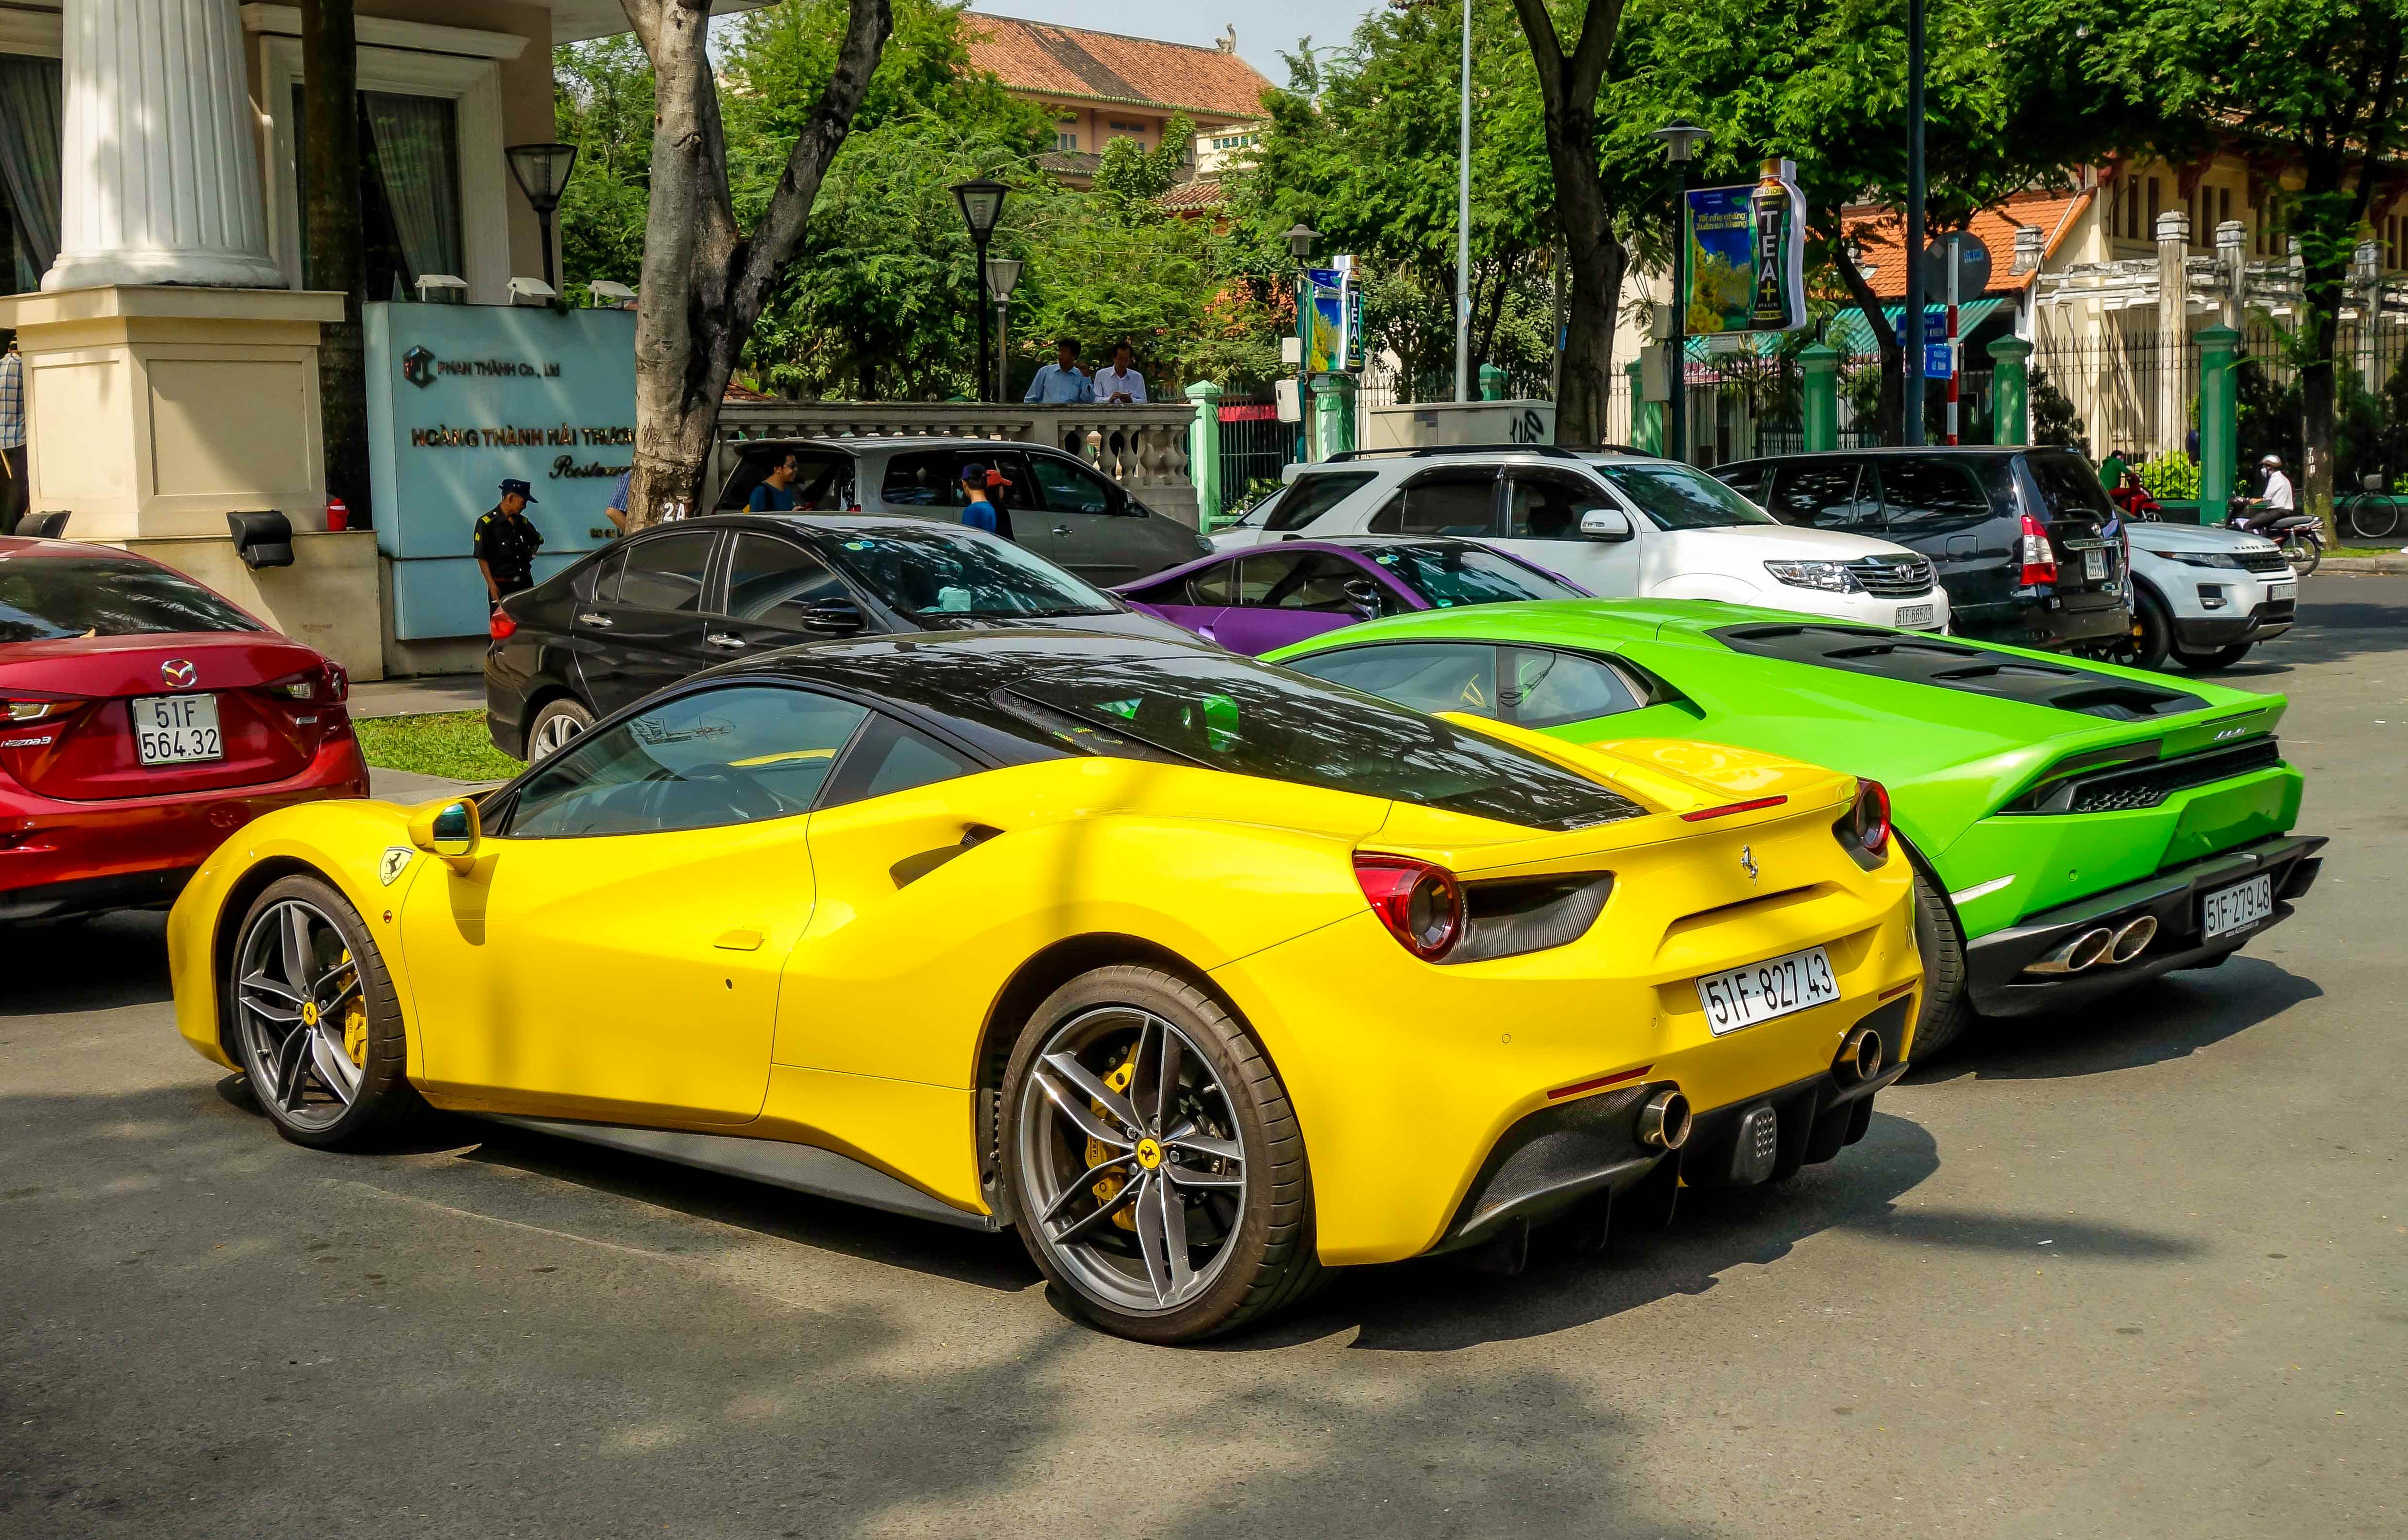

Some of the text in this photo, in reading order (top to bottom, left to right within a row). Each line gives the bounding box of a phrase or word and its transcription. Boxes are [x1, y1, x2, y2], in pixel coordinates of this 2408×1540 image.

[411, 424, 479, 446] HOÀNG
[481, 424, 544, 446] THÀNH
[663, 502, 686, 523] 2A
[155, 700, 196, 729] 51F
[141, 728, 219, 759] 564.32
[2207, 879, 2269, 931] 51F-279.48
[1705, 953, 1832, 1024] 51F-827.43
